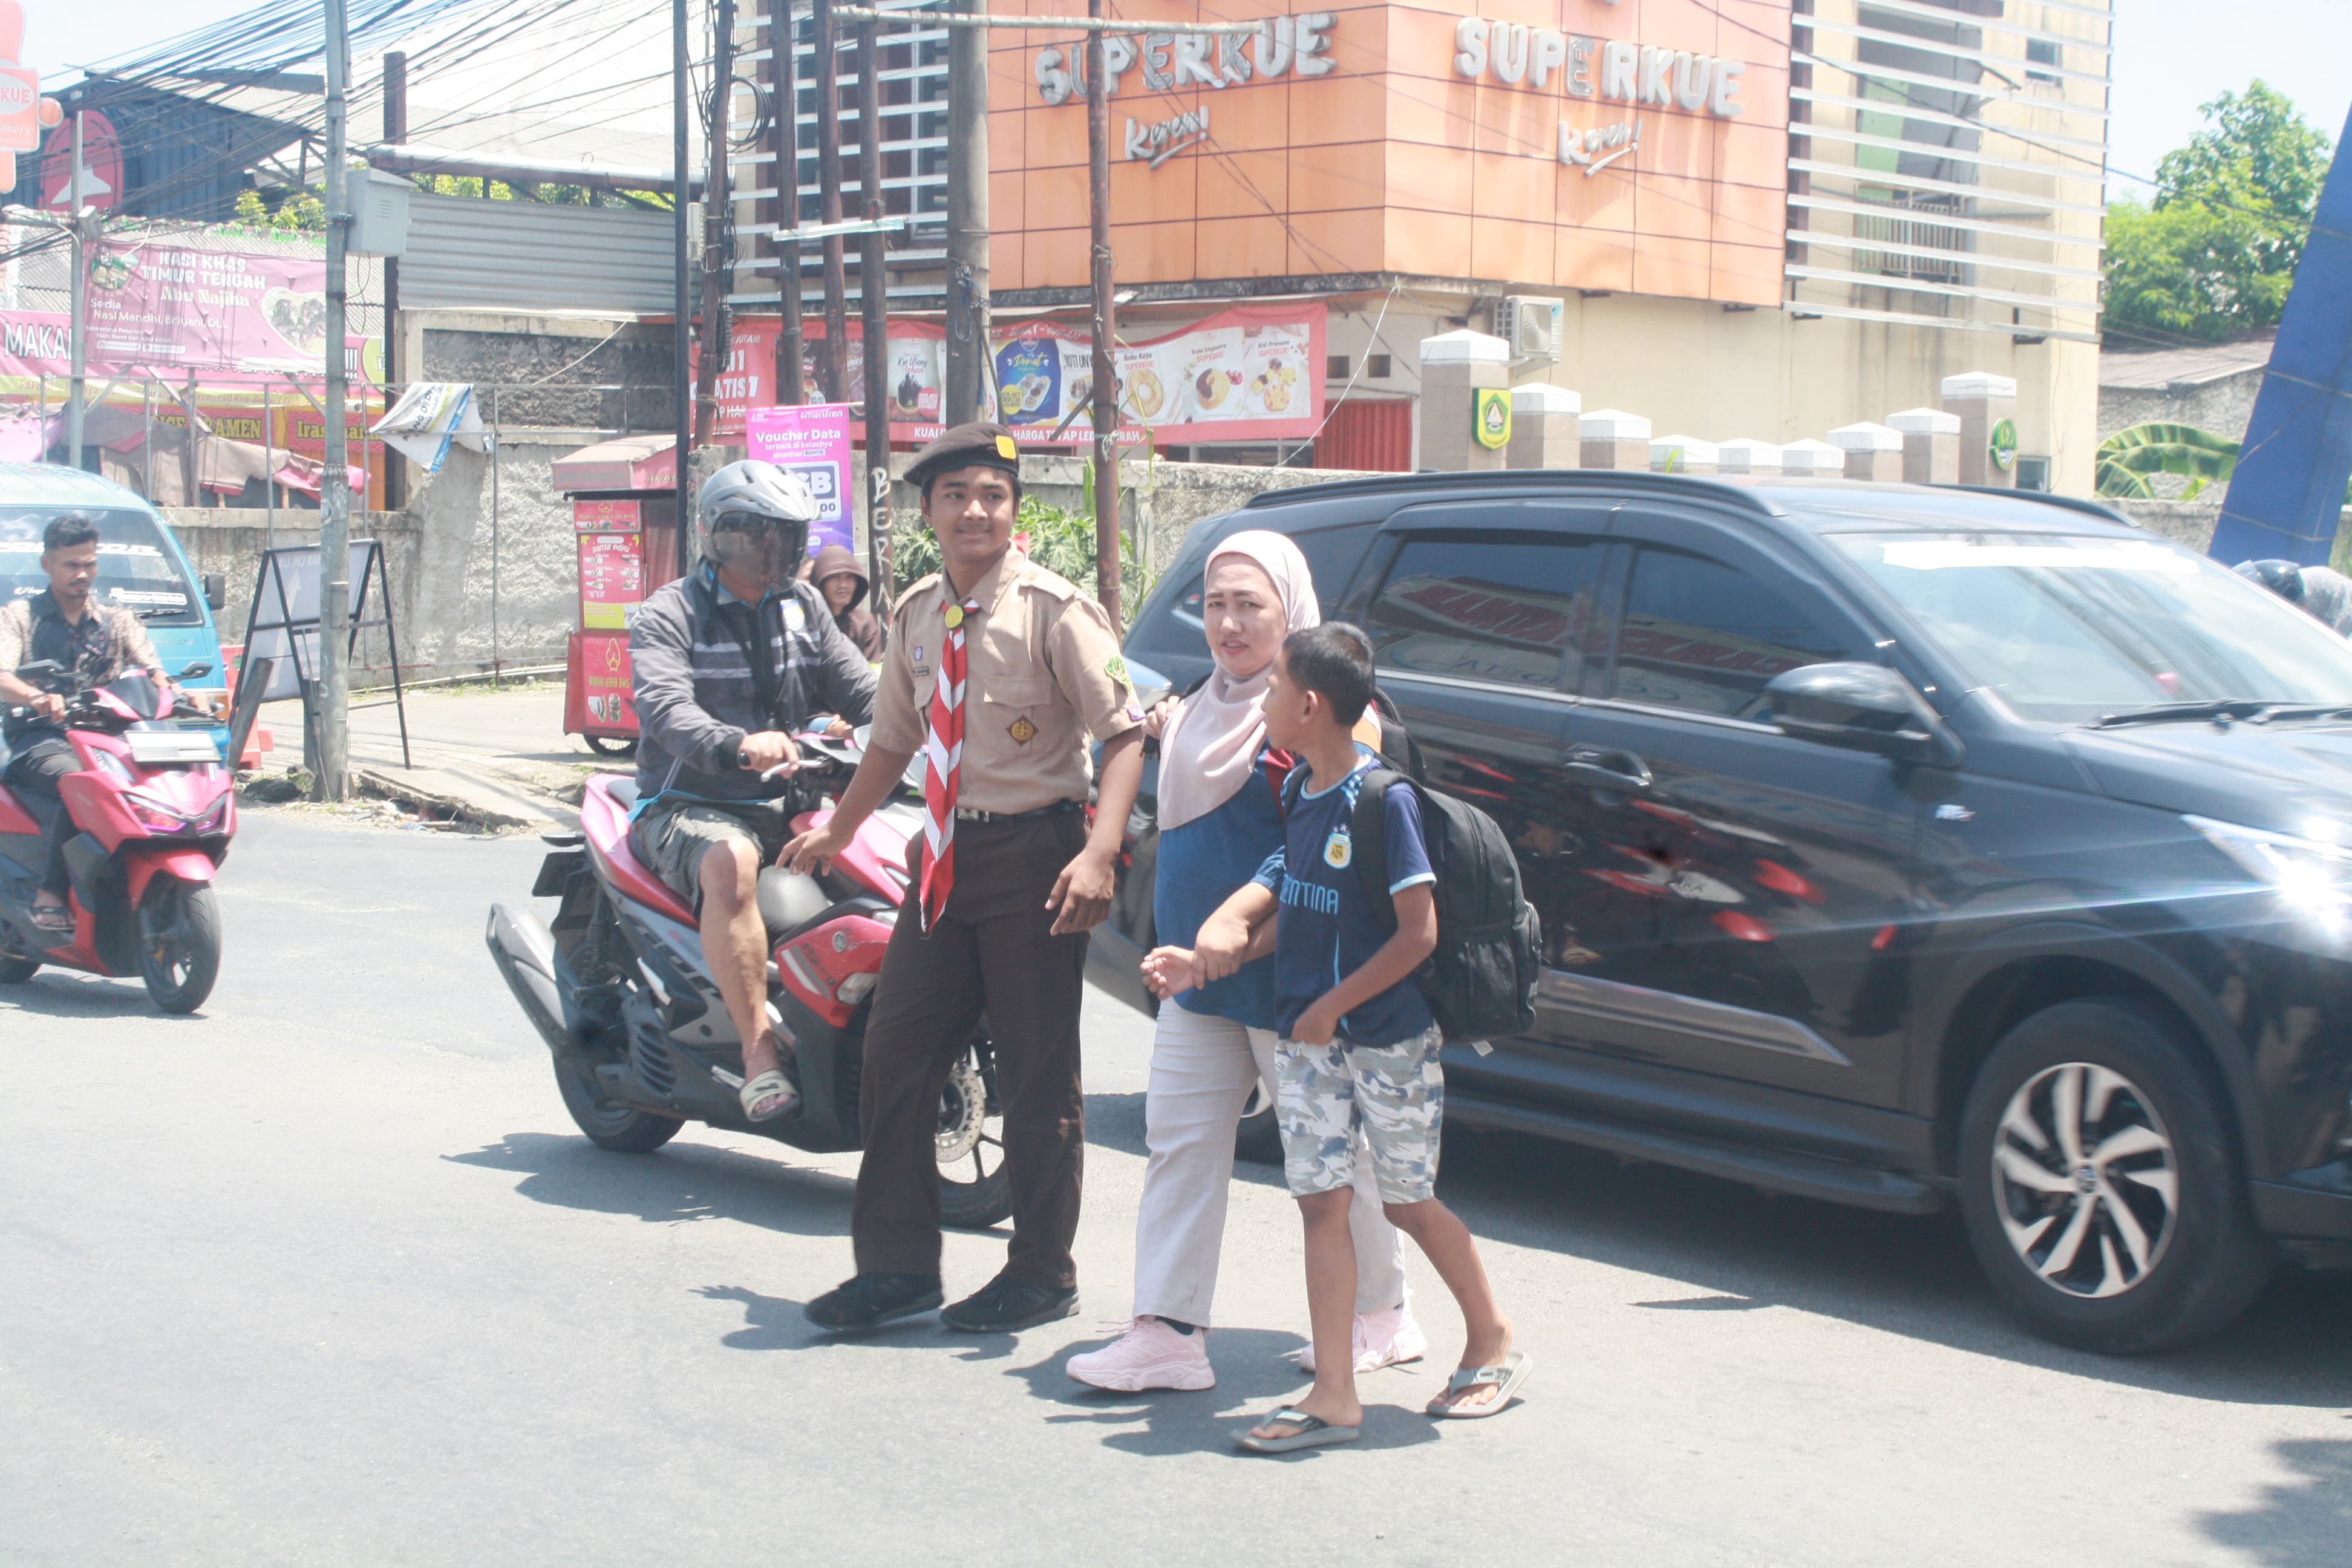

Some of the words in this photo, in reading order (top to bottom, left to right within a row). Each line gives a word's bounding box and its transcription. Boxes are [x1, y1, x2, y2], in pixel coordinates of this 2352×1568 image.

[1454, 16, 1746, 117] SUPERKUE
[201, 254, 246, 273] KHAS
[140, 264, 196, 284] TIMUR
[199, 270, 266, 290] TENGAH
[90, 298, 122, 310] Sedia
[93, 309, 117, 321] Nasi
[207, 318, 229, 328] DLL
[4, 323, 71, 361] MAKA
[755, 429, 809, 443] Voucher
[811, 428, 841, 439] Data
